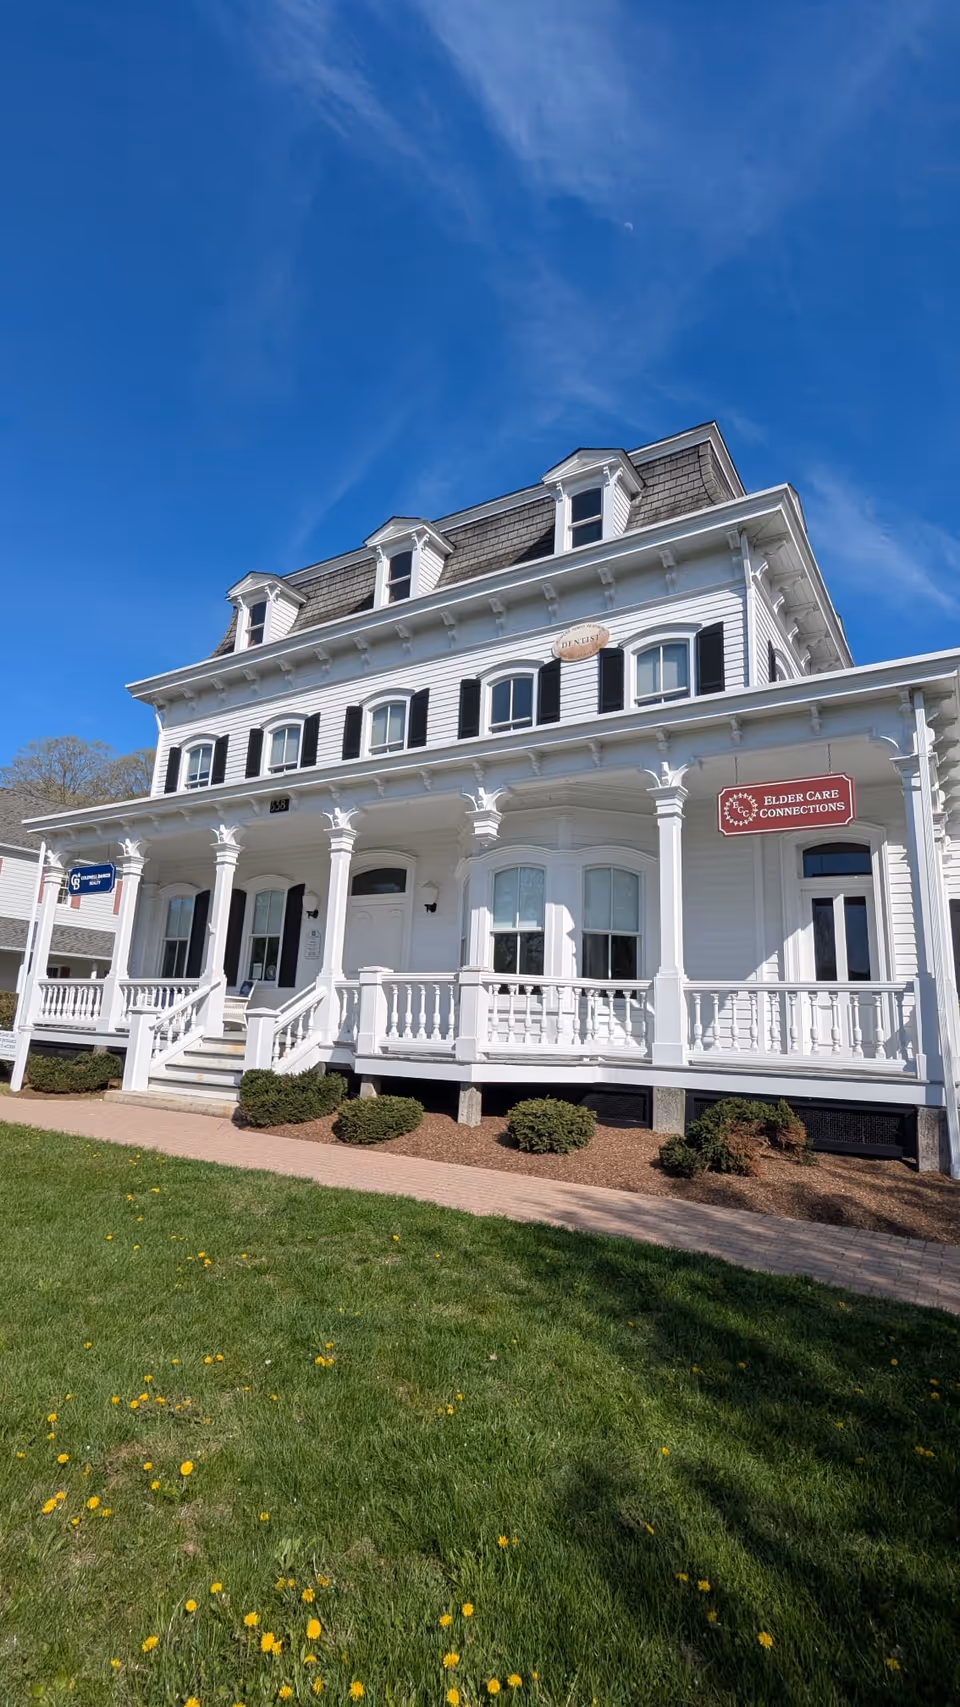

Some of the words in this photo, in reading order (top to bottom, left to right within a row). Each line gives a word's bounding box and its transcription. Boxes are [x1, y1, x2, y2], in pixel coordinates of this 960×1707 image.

[561, 634, 600, 649] DENTIST
[764, 793, 804, 806] ELDER
[806, 789, 840, 801] CARE
[732, 801, 750, 818] ECC
[760, 801, 846, 819] CONNECTIONS
